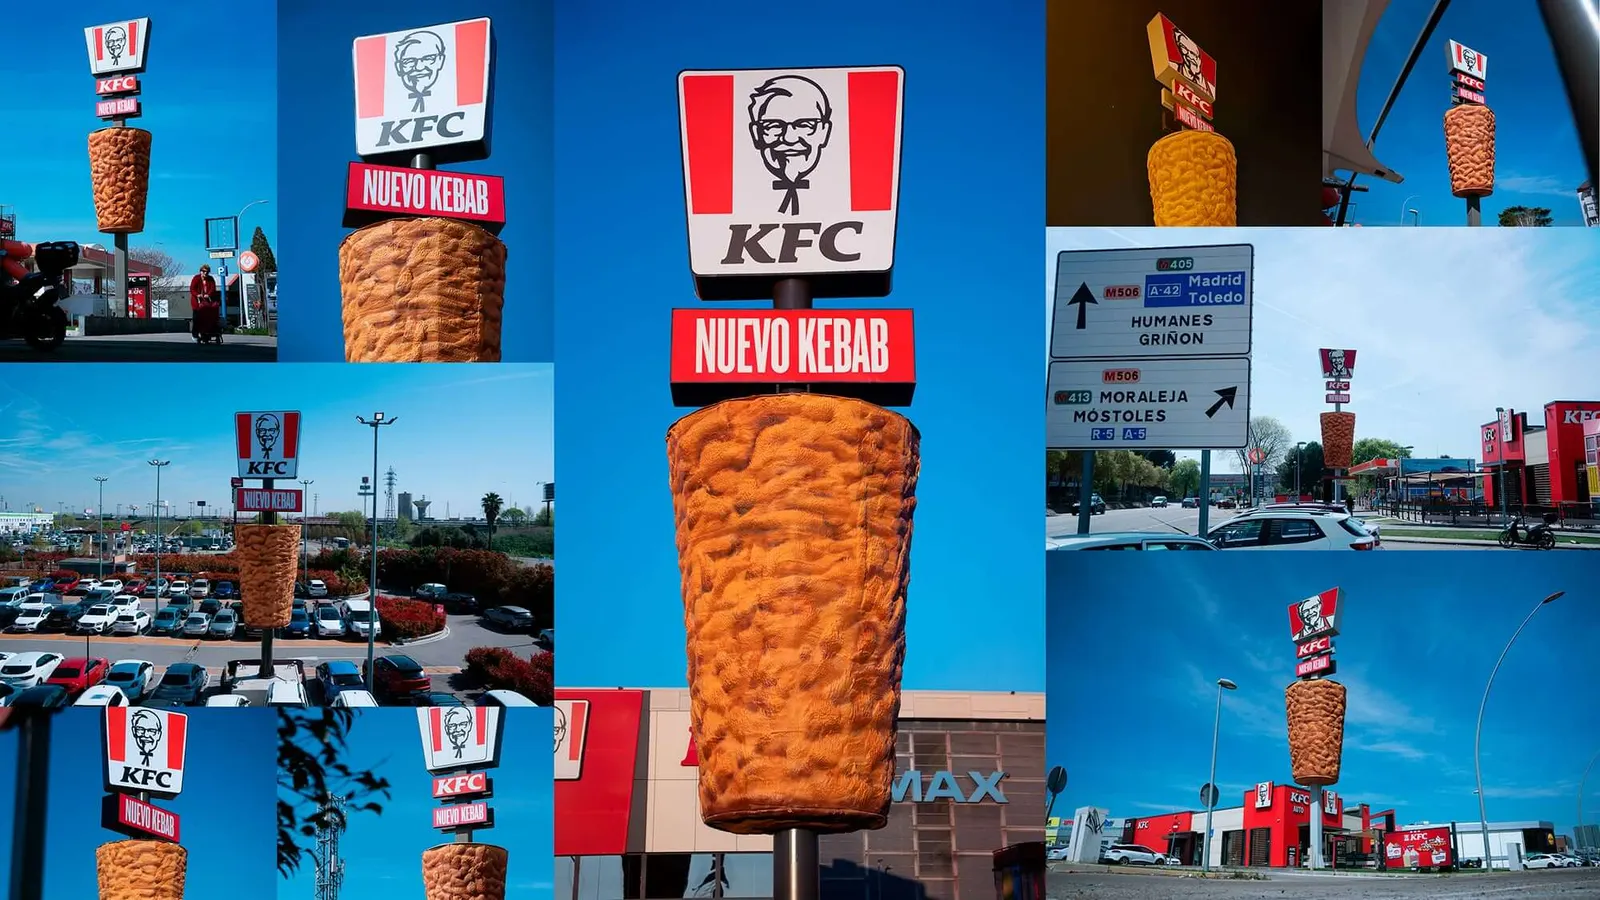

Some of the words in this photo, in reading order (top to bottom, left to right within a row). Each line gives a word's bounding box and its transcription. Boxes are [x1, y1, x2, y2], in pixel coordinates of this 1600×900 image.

[99, 77, 135, 93] KFC
[1460, 75, 1484, 90] KFC
[1178, 84, 1210, 113] KFC
[375, 111, 466, 147] KFC
[363, 169, 426, 209] NUEVO
[430, 175, 489, 215] KEBAB
[720, 221, 864, 264] KFC
[218, 266, 224, 274] P
[1159, 259, 1193, 271] M405
[1189, 274, 1242, 287] Madrid
[1105, 287, 1140, 298] M506
[1150, 286, 1179, 296] A-42
[1189, 291, 1243, 304] Toledo
[1131, 314, 1213, 328] HUMANES
[1139, 331, 1204, 345] GRIÑON
[695, 317, 790, 374] NUEVO
[798, 317, 889, 374] KEBAB
[1103, 370, 1139, 381] M506
[1056, 392, 1092, 403] M413
[1100, 390, 1188, 403] MORALEJA
[1073, 408, 1166, 423] MÓSTOLES
[1092, 429, 1114, 439] R-5
[1124, 429, 1146, 439] A-5
[247, 461, 288, 475] KFC
[244, 491, 270, 509] NUEVO
[271, 492, 297, 509] KEBAB
[1299, 638, 1328, 655] KFC
[120, 766, 172, 788] KFC
[435, 773, 483, 796] KFC
[1290, 791, 1310, 805] KFC
[125, 799, 151, 828] NUEVO
[151, 808, 175, 837] KEBAB
[436, 808, 460, 826] NUEVO
[461, 804, 484, 822] KEBAB
[1137, 821, 1149, 829] KFC
[1410, 833, 1427, 841] KFC
